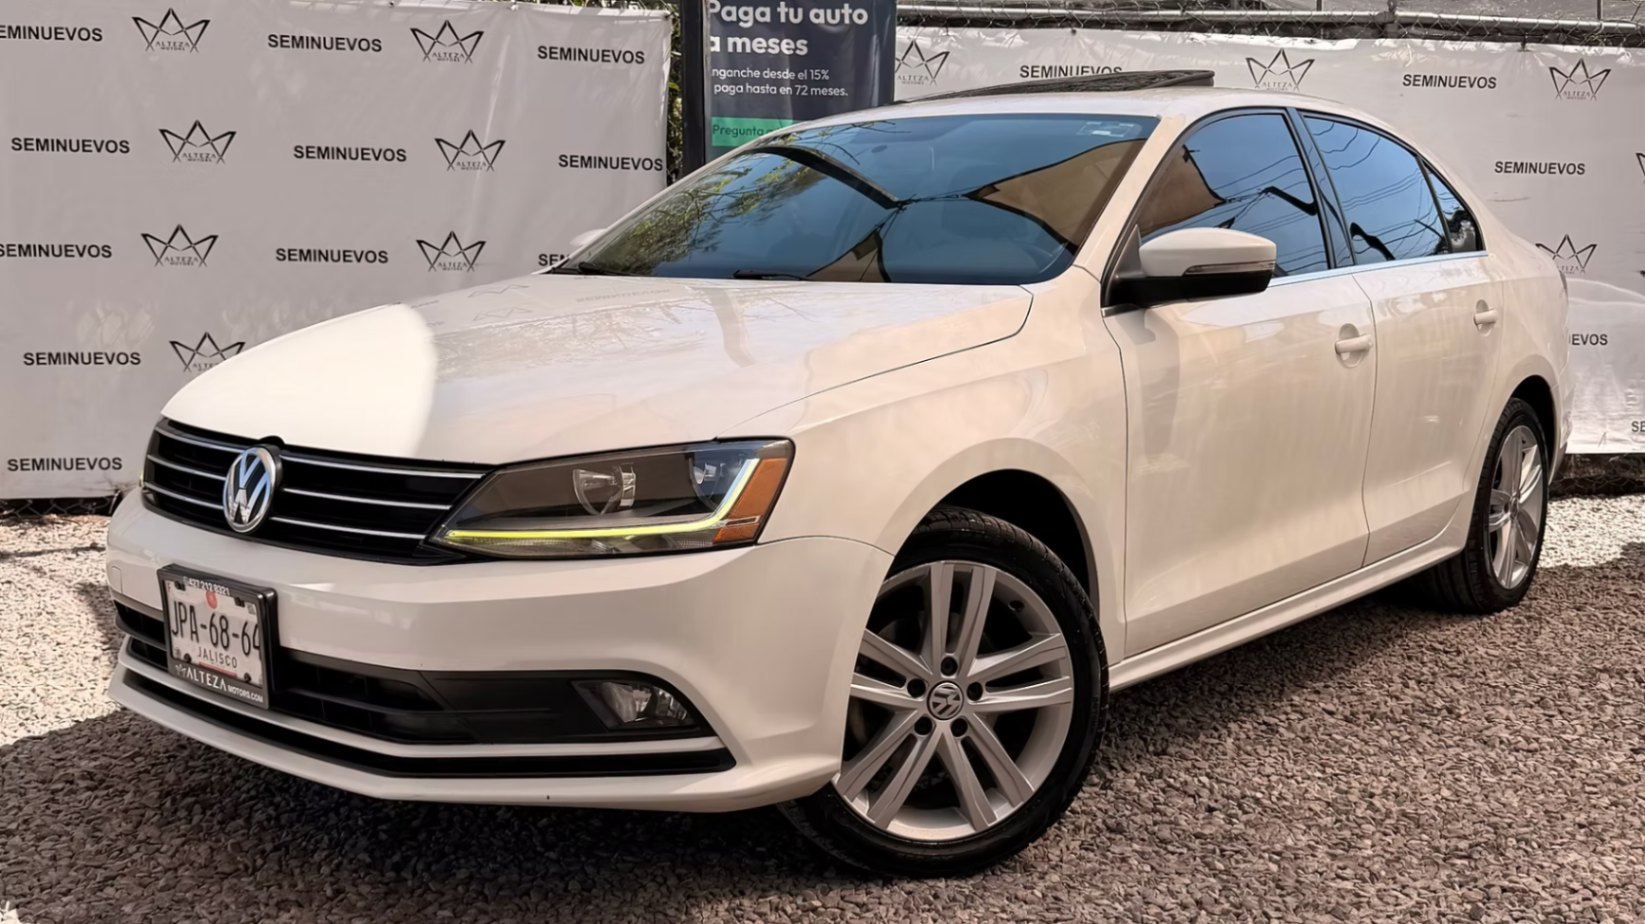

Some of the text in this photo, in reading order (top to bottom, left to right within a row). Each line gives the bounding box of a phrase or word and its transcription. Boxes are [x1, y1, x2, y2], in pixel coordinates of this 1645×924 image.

[709, 0, 868, 28] Paga tu auto
[267, 34, 382, 52] SEMINUEVOS
[709, 36, 808, 55] a meses
[537, 45, 645, 64] SEMINUEVOS
[763, 68, 796, 80] desde
[797, 69, 808, 80] el
[810, 69, 830, 81] 15%
[1402, 74, 1497, 89] SEMINUEVOS
[714, 83, 849, 97] paga hasta en 72 meses.
[712, 124, 764, 138] Pregunta
[11, 138, 130, 154] SEMINUEVOS
[293, 145, 407, 162] SEMINUEVOS
[558, 154, 664, 171] SEMINUEVOS
[1494, 161, 1586, 175] SEMINUEVOS
[275, 248, 389, 264] SEMINUEVOS
[23, 351, 142, 366] SEMINUEVOS
[7, 457, 123, 472] SEMINUEVOS
[197, 646, 238, 669] JALISCO
[186, 667, 227, 692] ALTEZA
